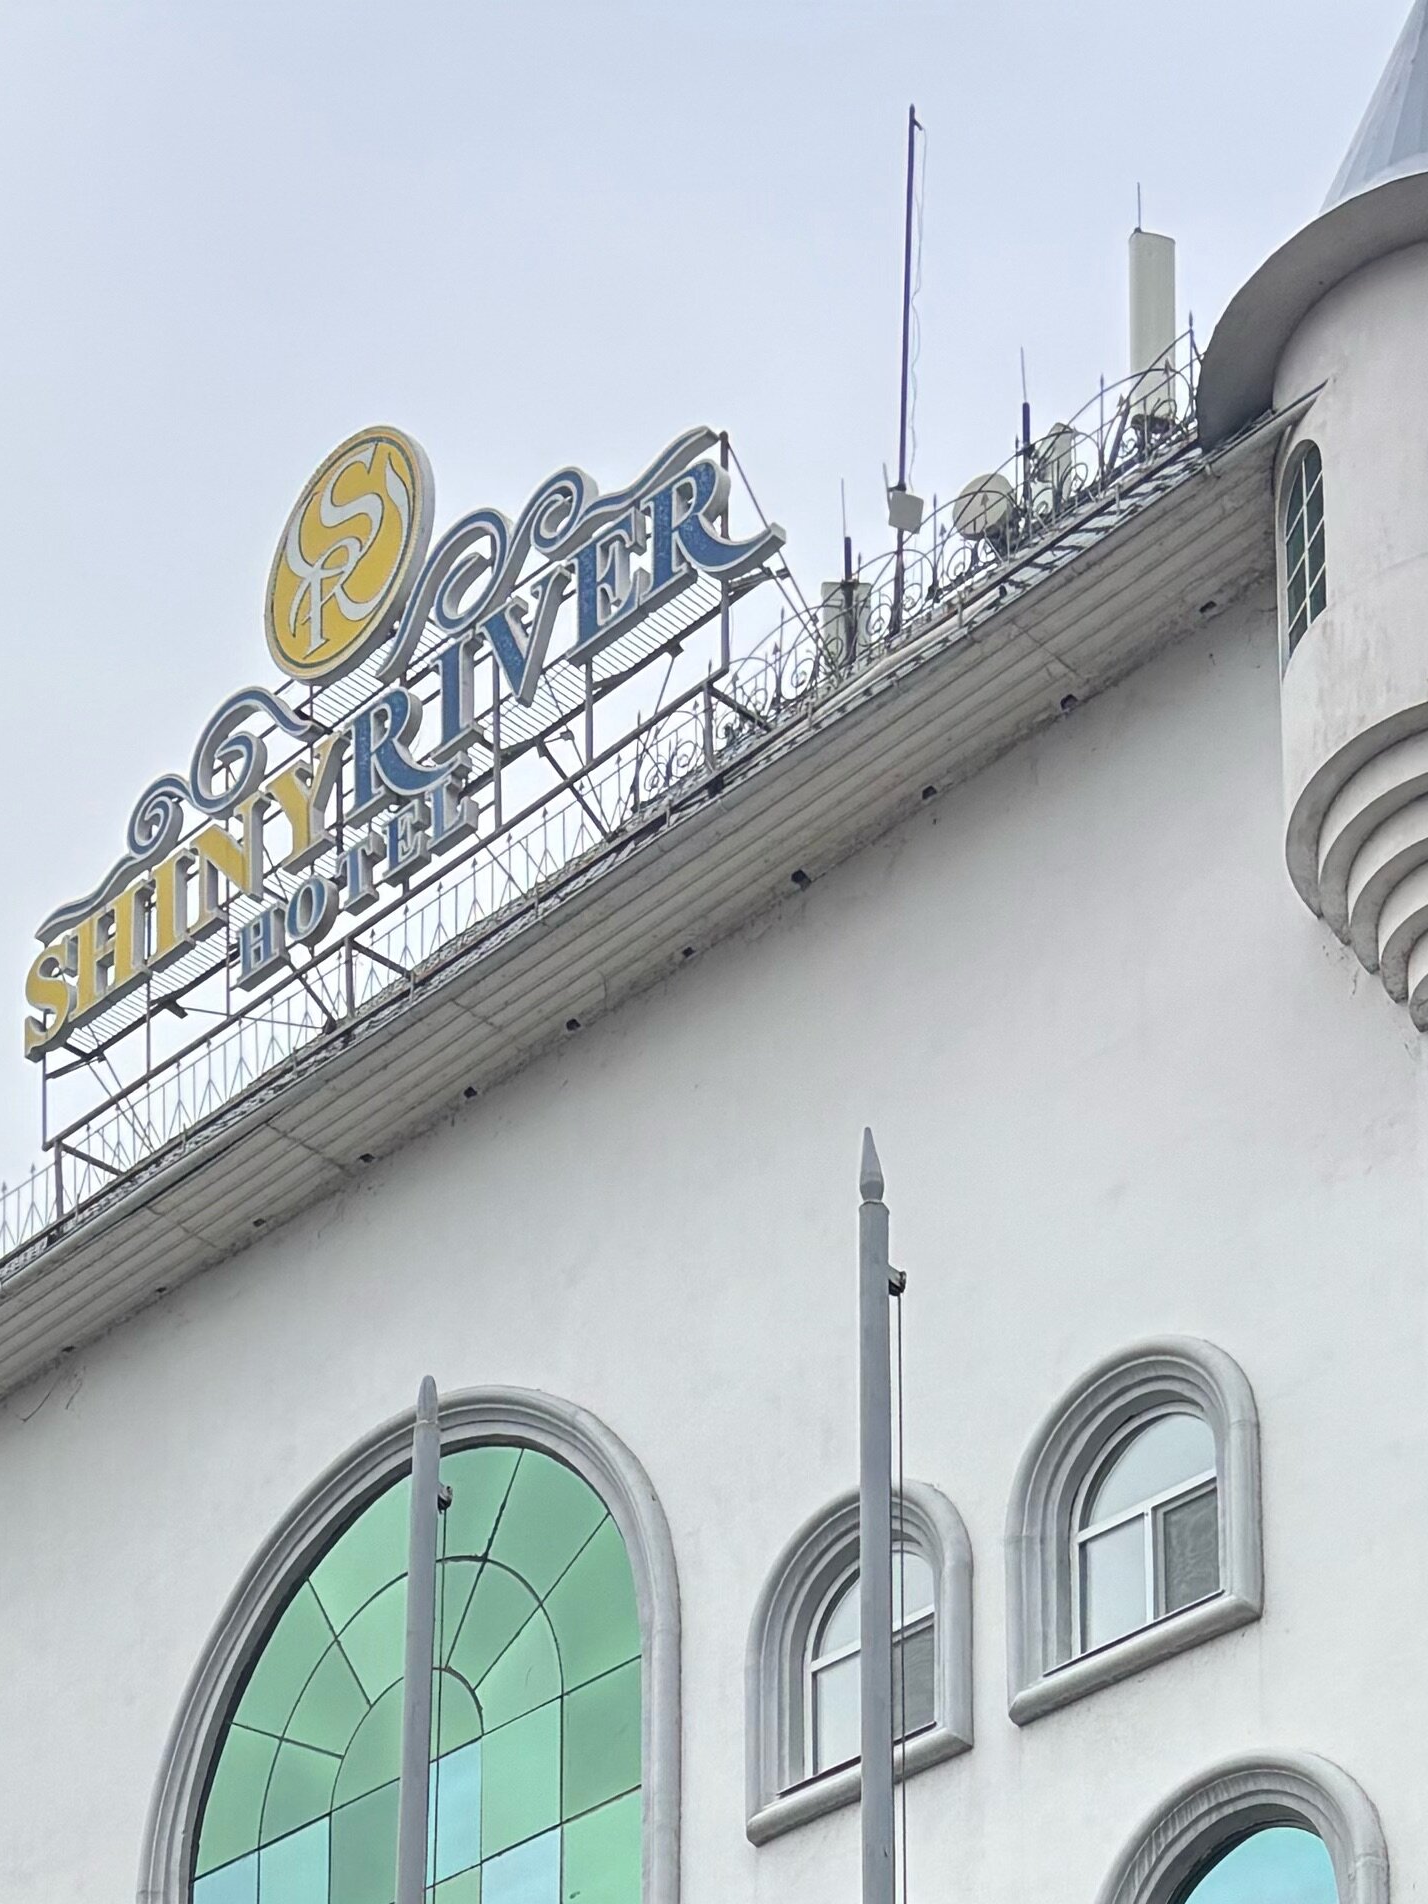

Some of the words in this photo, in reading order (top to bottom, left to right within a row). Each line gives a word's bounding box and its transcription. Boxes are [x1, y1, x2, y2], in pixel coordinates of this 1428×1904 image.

[25, 730, 350, 1060] SHINY
[342, 459, 786, 828] RIVER
[236, 772, 479, 993] HOTEL
